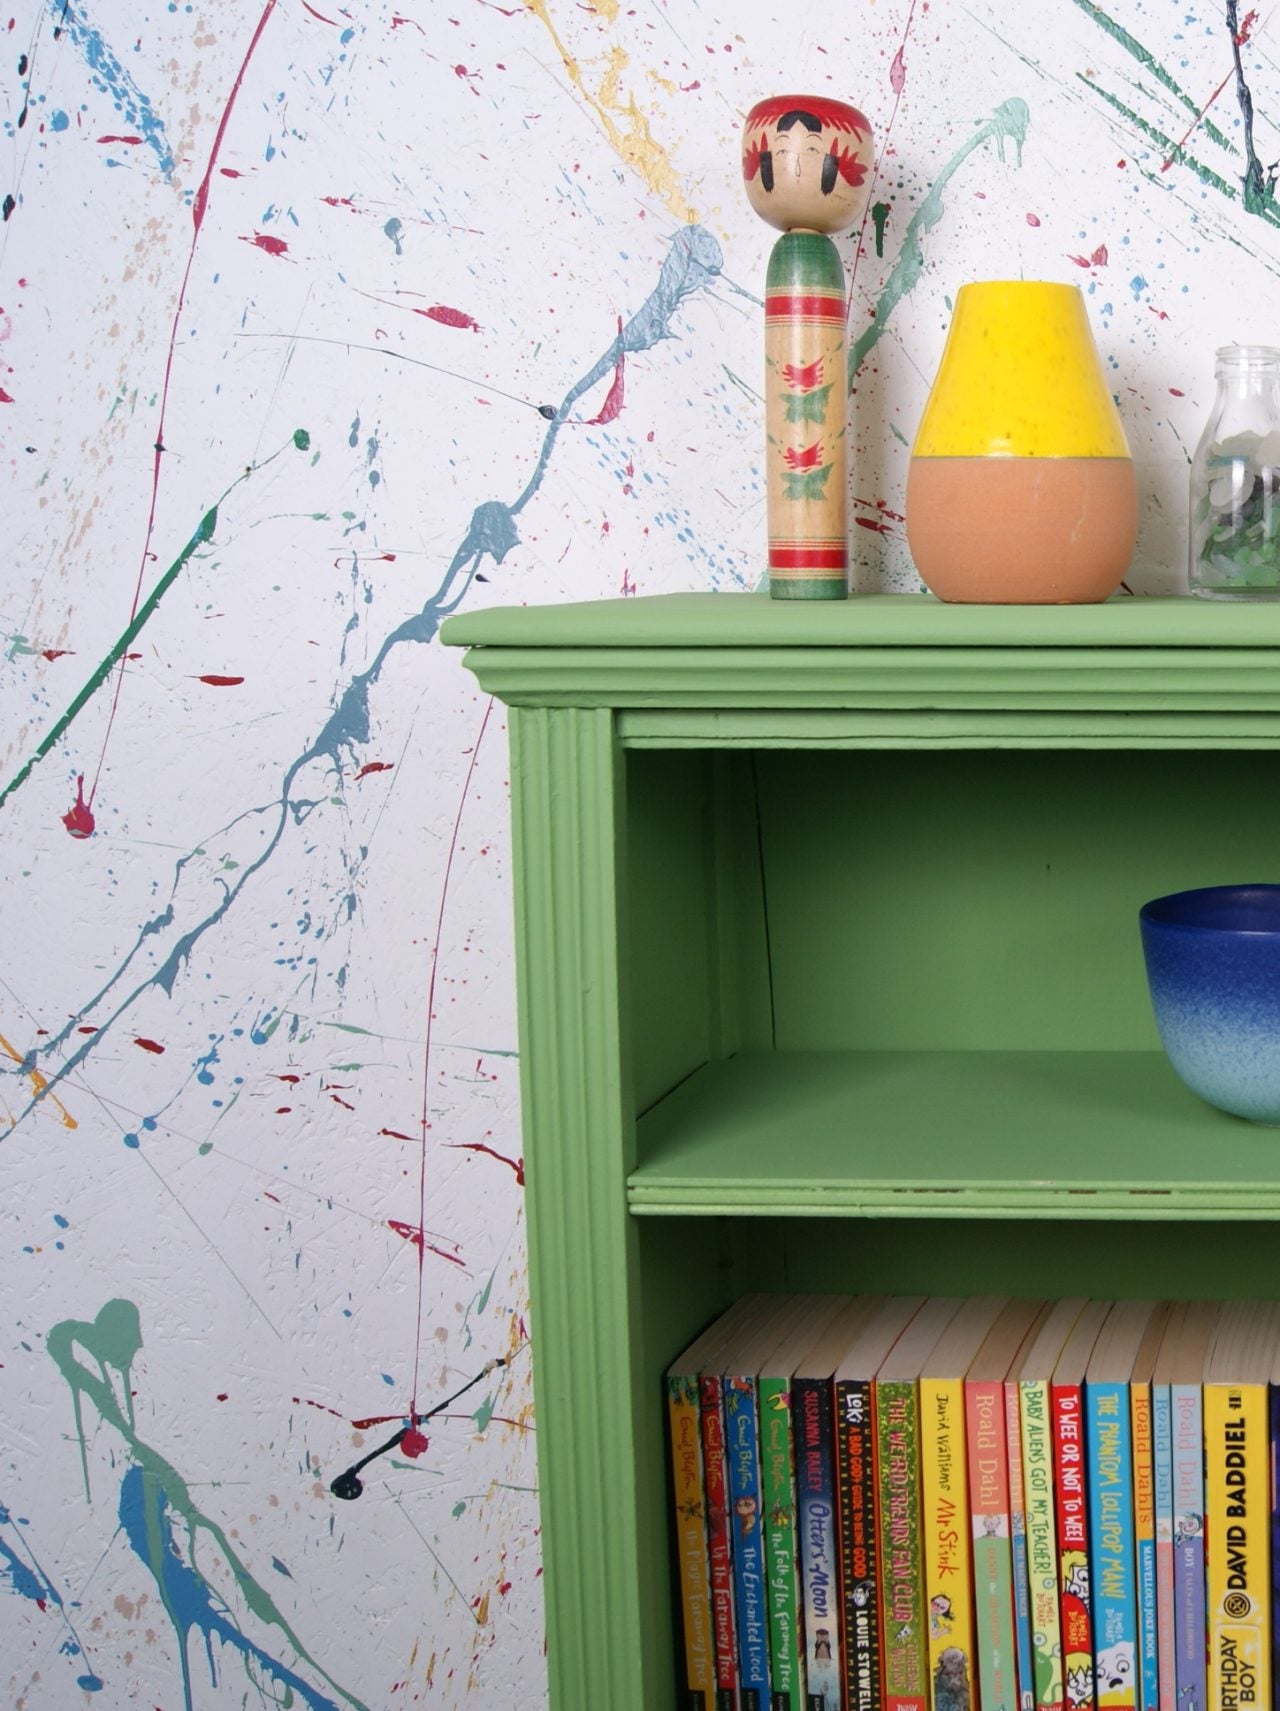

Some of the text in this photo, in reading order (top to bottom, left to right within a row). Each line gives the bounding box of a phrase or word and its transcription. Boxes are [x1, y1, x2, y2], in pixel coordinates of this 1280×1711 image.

[804, 1391, 820, 1447] SUSANNA
[888, 1397, 908, 1425] THE
[1060, 1413, 1079, 1440] WEE
[849, 1435, 862, 1455] BAD
[936, 1393, 953, 1491] David Walliams
[975, 1394, 999, 1506] Roald Dahl
[1061, 1443, 1080, 1464] OR
[1135, 1398, 1152, 1524] Roald Dahl's
[1156, 1399, 1171, 1509] Roald Dahl
[1177, 1396, 1198, 1509] Roald Dahl
[681, 1451, 695, 1489] Blyton
[708, 1451, 722, 1488] Blyton
[739, 1451, 753, 1490] Blyton
[771, 1454, 785, 1492] Blyton
[1025, 1389, 1052, 1574] BABY ALIENS GOT MY TEACHER!
[852, 1485, 864, 1510] GUIDE
[1096, 1392, 1127, 1599] THE PHANTOM LOLLIPOP MAN!
[1224, 1417, 1247, 1590] DAVID BADDIEL
[853, 1522, 864, 1546] BEING
[936, 1498, 960, 1579] Mr Stink
[1064, 1515, 1085, 1541] WEE!
[774, 1550, 790, 1576] Folk
[853, 1547, 866, 1578] GOOD
[892, 1549, 913, 1579] FAN
[1184, 1547, 1194, 1568] BOY
[771, 1578, 788, 1590] of
[810, 1564, 830, 1618] Moon
[893, 1582, 914, 1622] CLUB
[1142, 1545, 1154, 1659] MARVELLOUS JOKE BOOK
[714, 1589, 731, 1649] Faraway
[742, 1572, 762, 1643] Enchanted
[774, 1611, 790, 1660] Faraway
[1078, 1613, 1087, 1642] PAMELA
[718, 1653, 732, 1681] Tree
[749, 1646, 764, 1681] Wood
[780, 1662, 792, 1691] Tree
[855, 1610, 871, 1711] LOUIE STOWELL
[1239, 1660, 1255, 1702] BOY
